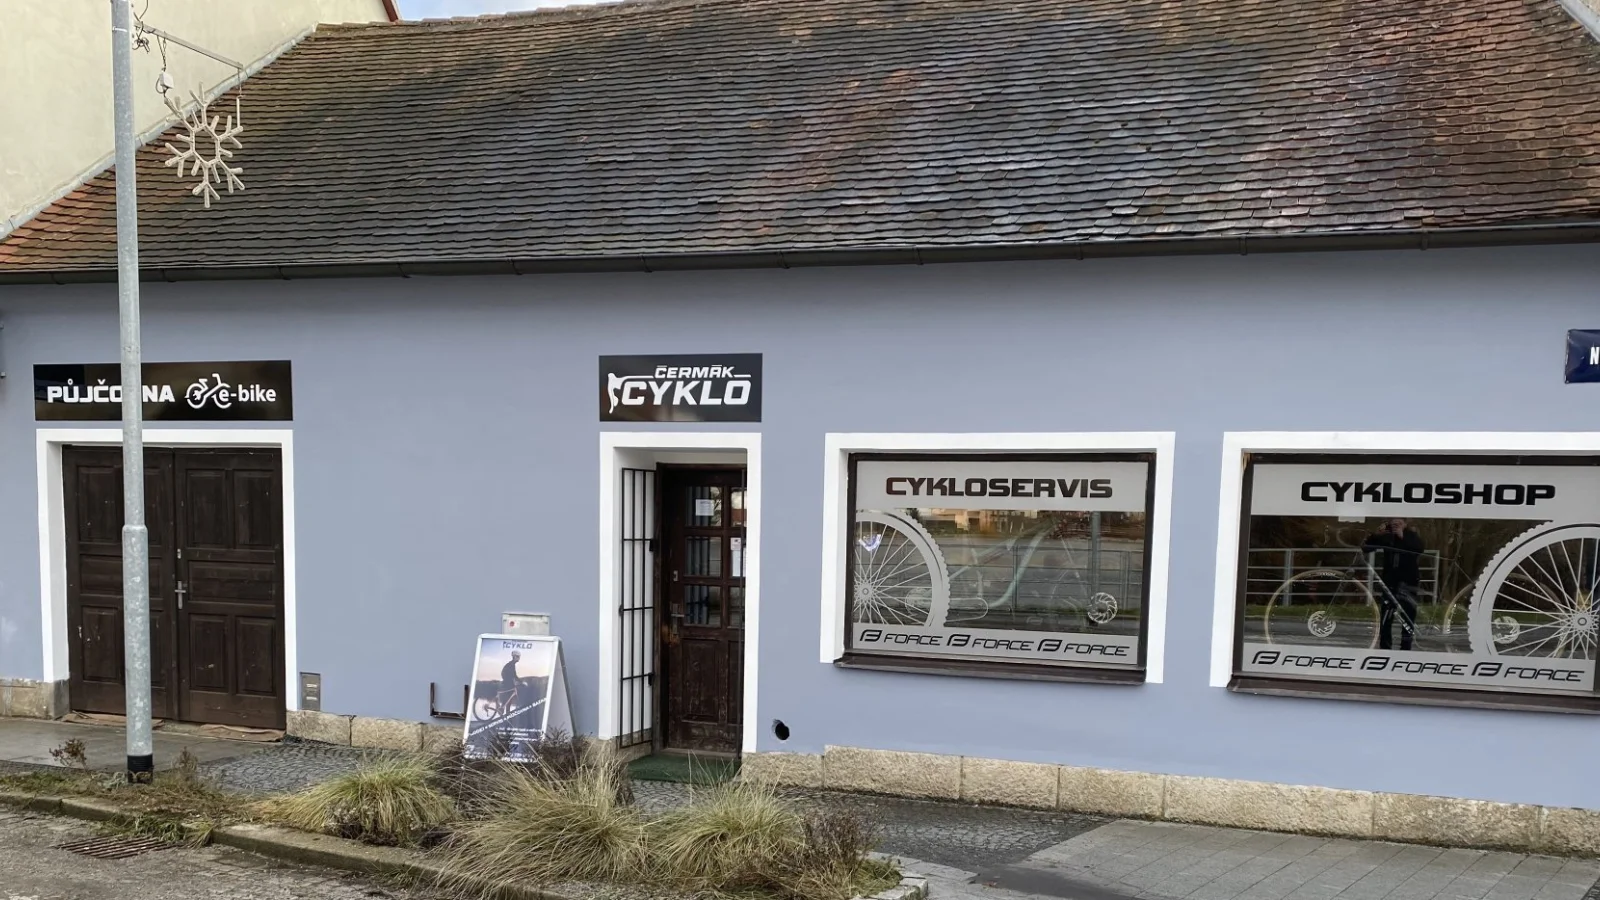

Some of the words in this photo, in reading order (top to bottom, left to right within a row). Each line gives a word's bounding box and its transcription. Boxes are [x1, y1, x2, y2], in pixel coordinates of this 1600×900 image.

[47, 379, 176, 404] PŮJČONA
[218, 383, 277, 403] e-bike
[621, 380, 752, 406] CYKLO
[886, 477, 1113, 499] CYKLOSERVIS
[1301, 481, 1556, 506] CYKLOSHOP
[883, 633, 943, 646] FORCE
[972, 638, 1035, 652] FORCE
[1063, 643, 1130, 656] FORCE
[1281, 655, 1356, 670] FORCE
[1391, 660, 1468, 677] FORCE
[1504, 667, 1585, 682] FORCE
